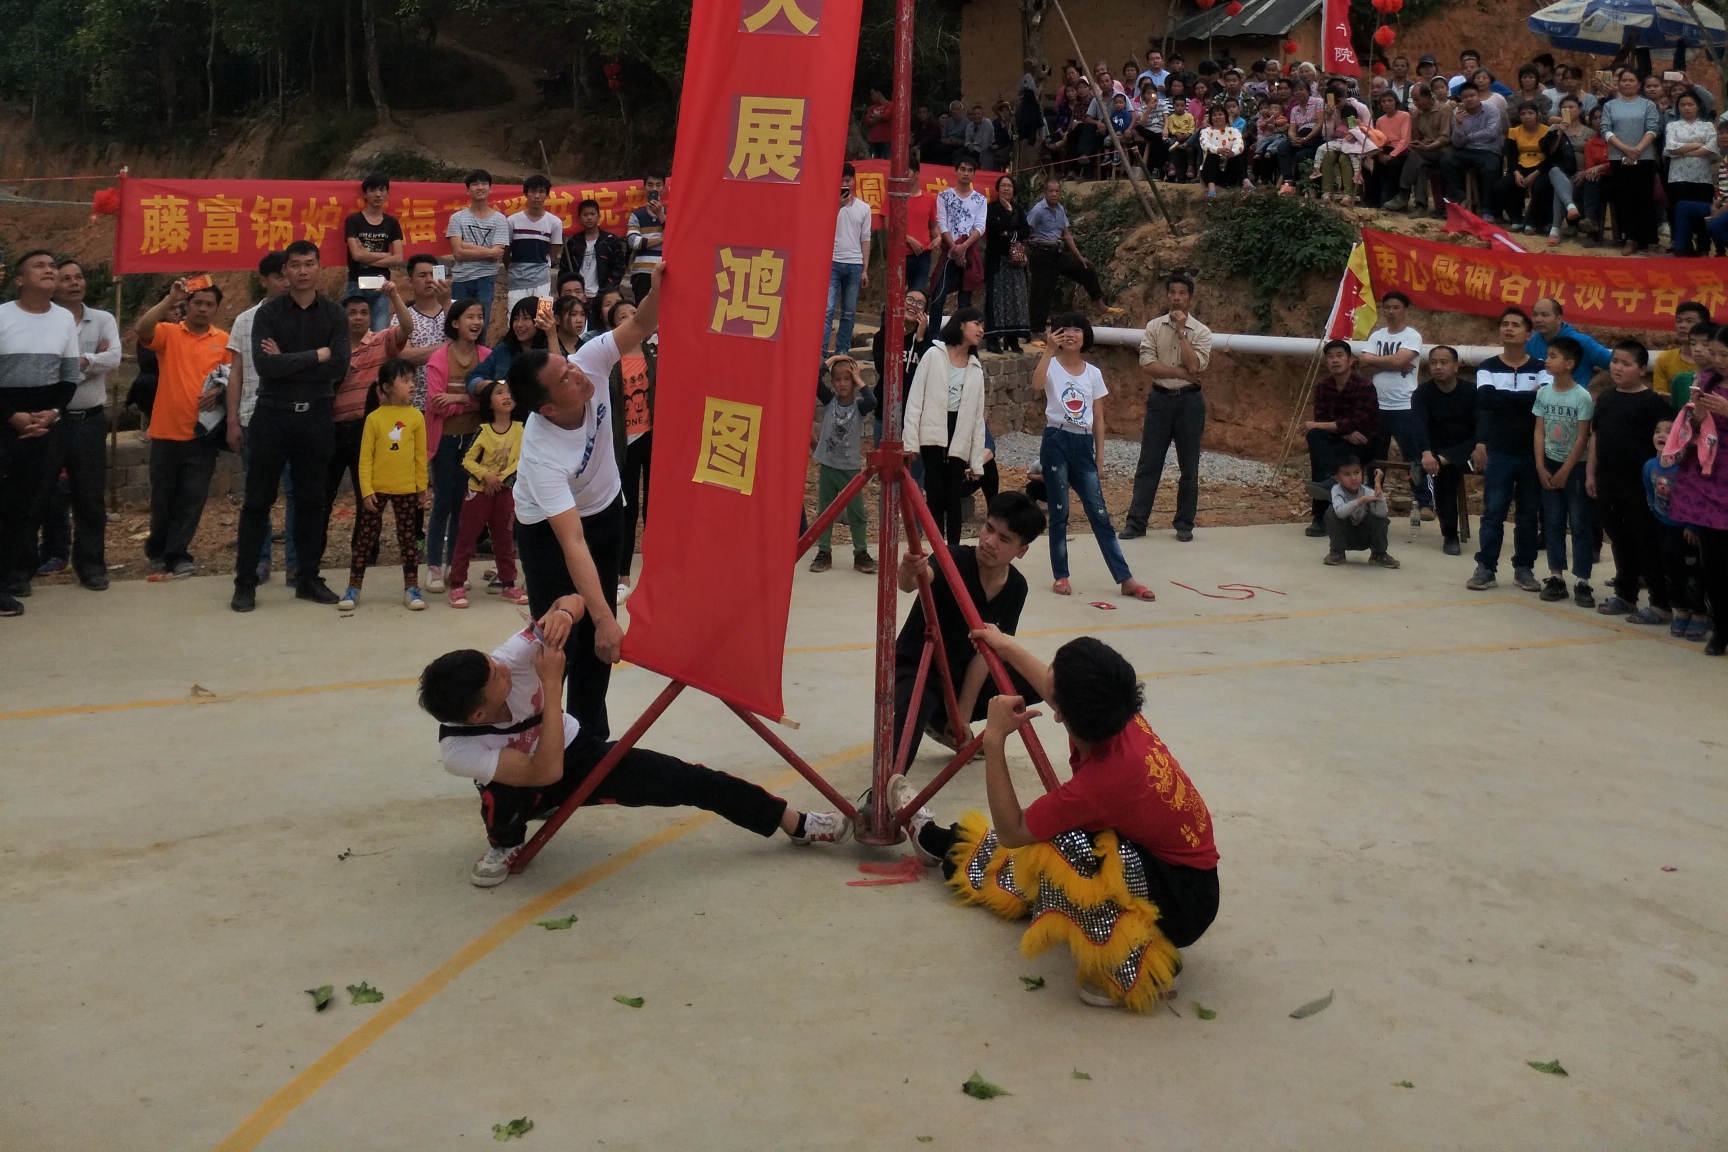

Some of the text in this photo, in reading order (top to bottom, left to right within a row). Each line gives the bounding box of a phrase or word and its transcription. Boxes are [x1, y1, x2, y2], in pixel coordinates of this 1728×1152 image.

[1372, 243, 1727, 318] 衷心感谢各位领导各界
[625, 416, 645, 428] ONE
